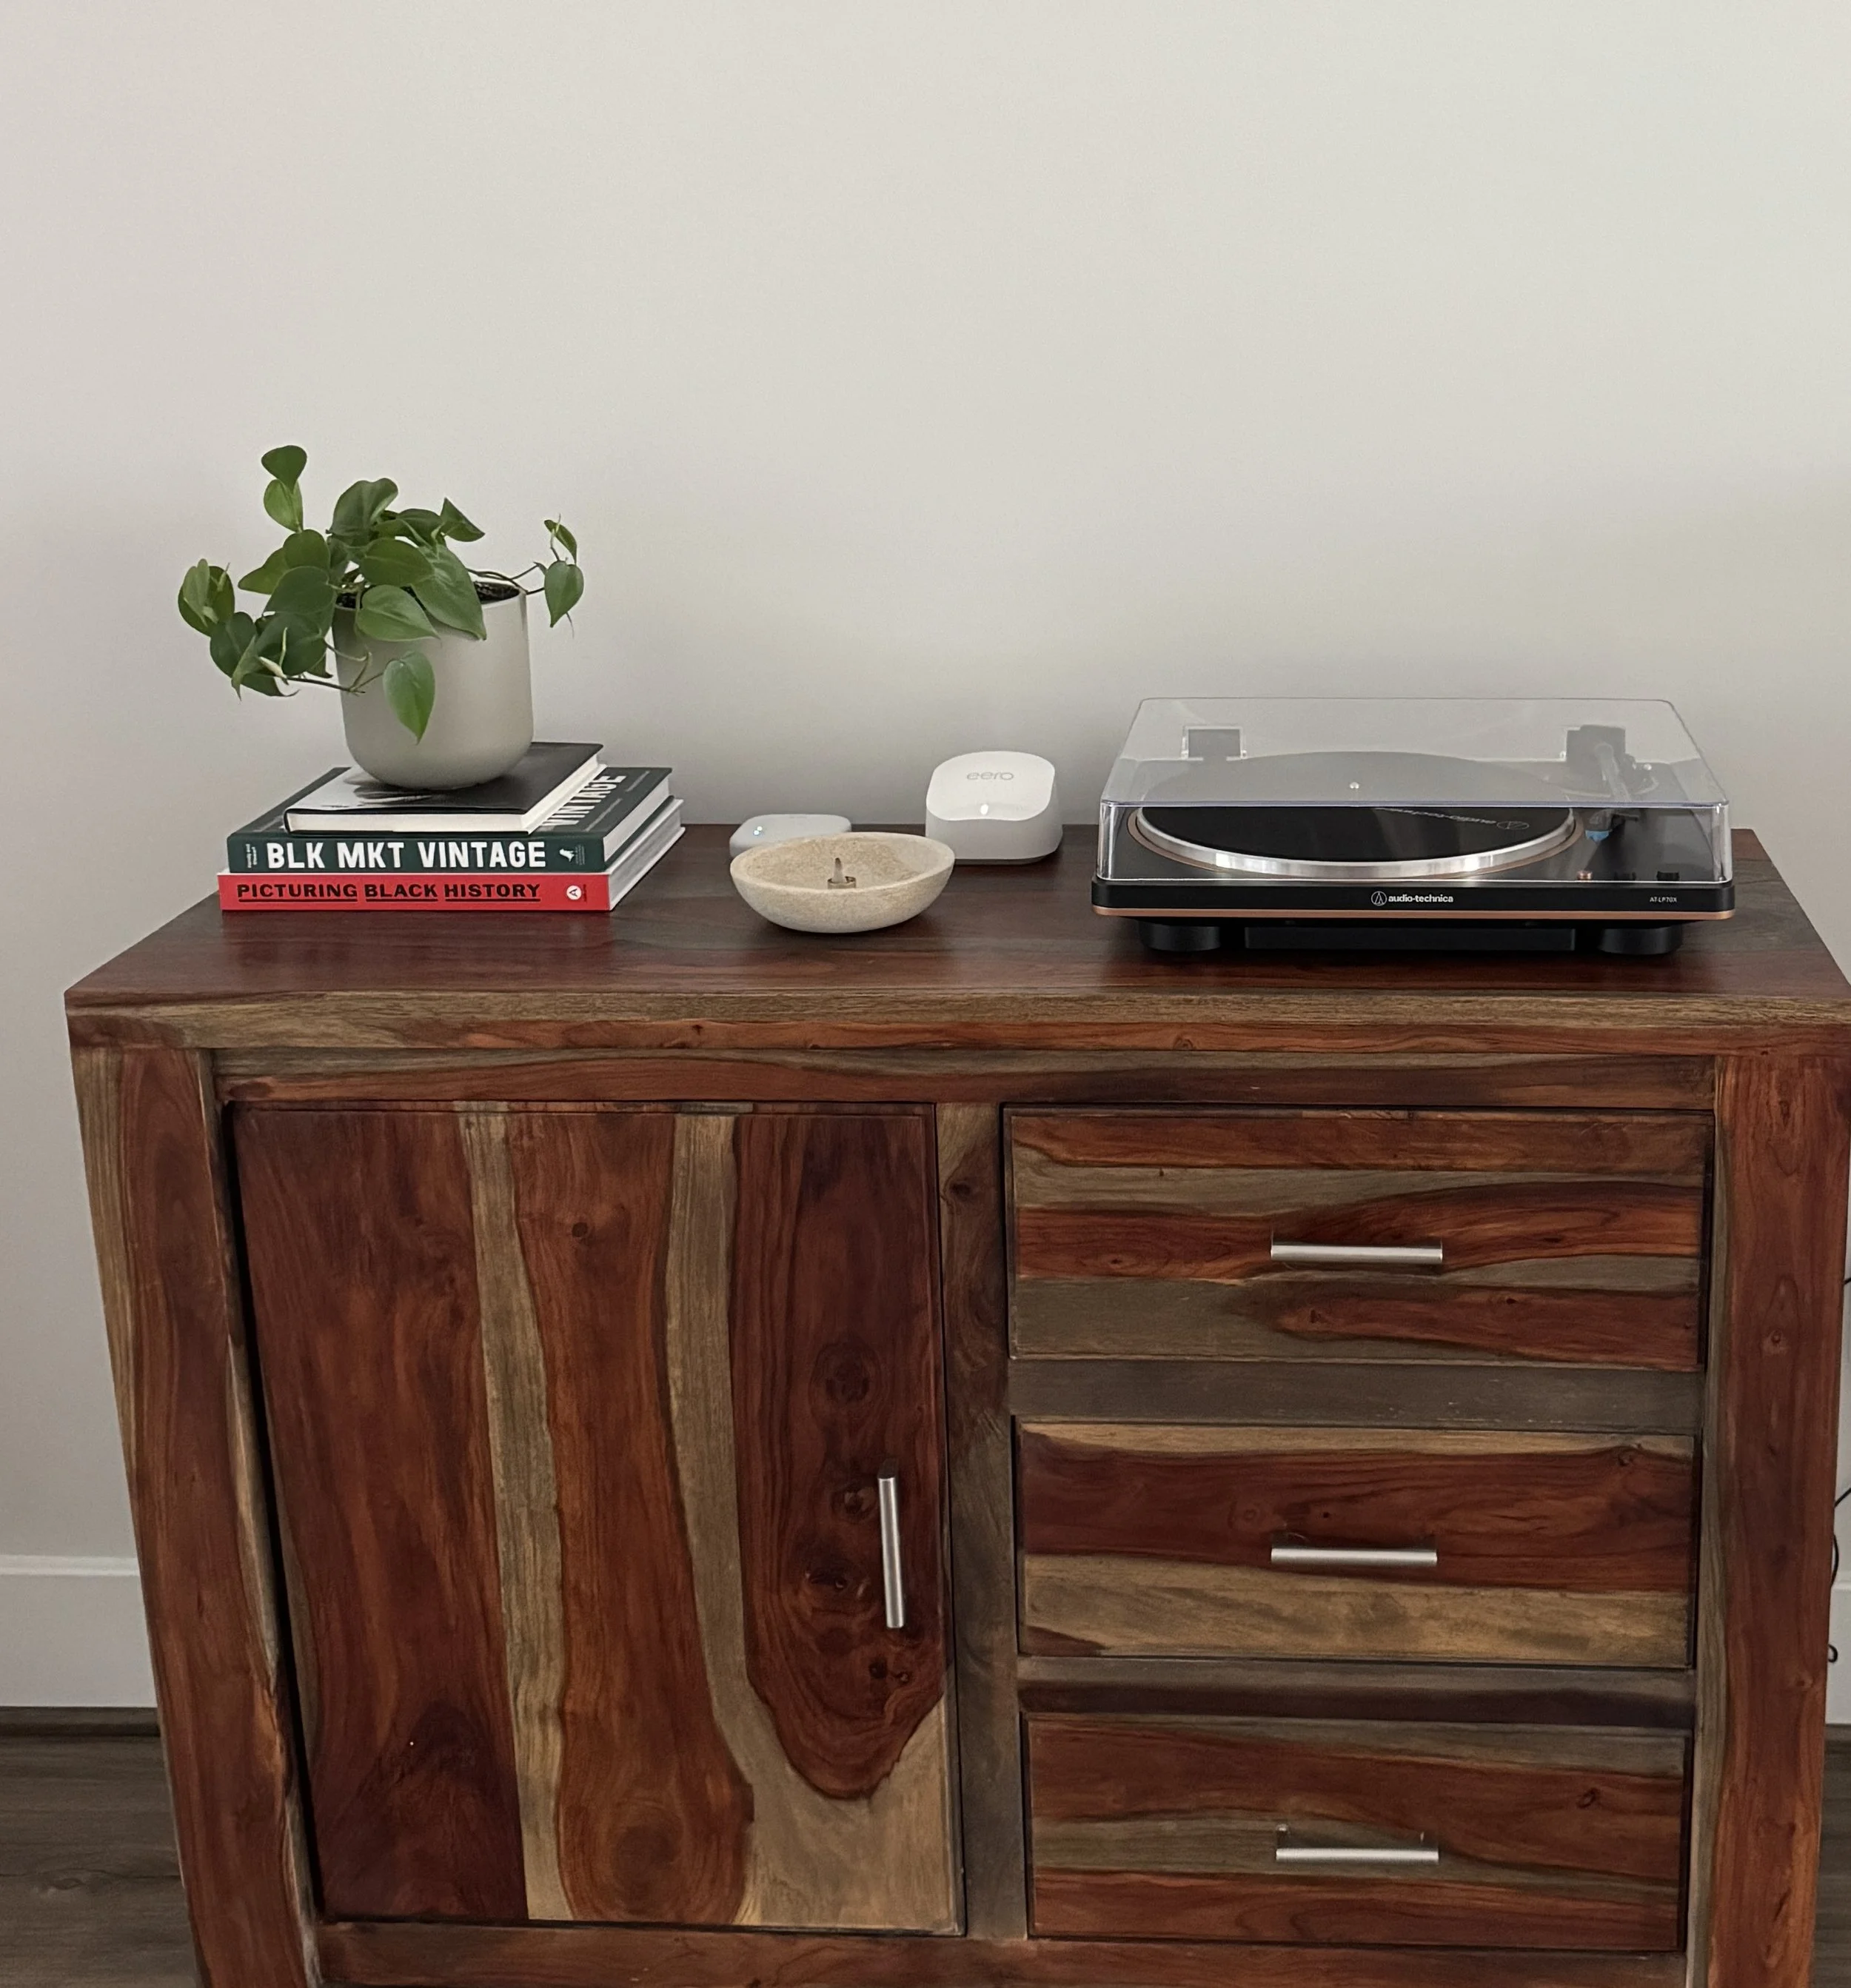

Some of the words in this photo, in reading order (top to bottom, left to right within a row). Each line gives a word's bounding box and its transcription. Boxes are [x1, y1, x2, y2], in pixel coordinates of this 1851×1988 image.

[966, 772, 1014, 780] eero
[266, 842, 326, 869] BLK
[336, 841, 405, 869] MKT
[417, 841, 546, 869] VINTAGE
[237, 883, 358, 898] PICTURING
[364, 883, 438, 898] BLACK
[444, 883, 540, 898] HISTORY
[1388, 894, 1454, 903] audio-technica
